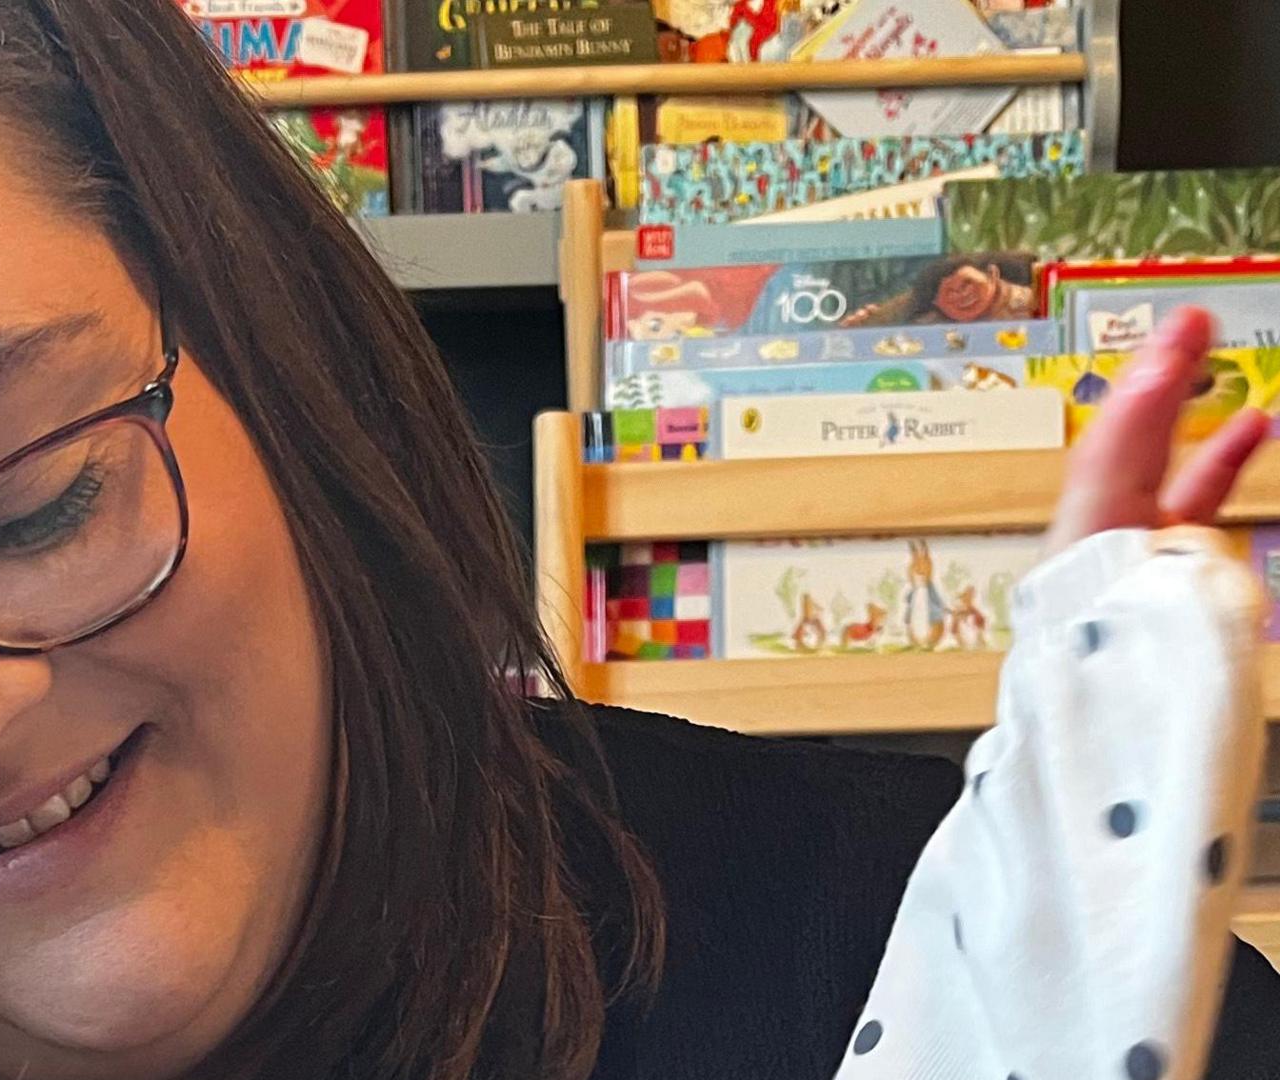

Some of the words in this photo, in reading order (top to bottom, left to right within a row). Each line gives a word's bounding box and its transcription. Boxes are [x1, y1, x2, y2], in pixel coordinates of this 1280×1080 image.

[511, 19, 541, 38] THE
[547, 17, 583, 35] TALE
[588, 18, 611, 34] OF
[494, 42, 573, 60] BENJAMIN
[576, 38, 631, 56] BUNNY
[792, 273, 831, 289] Disney
[776, 289, 847, 325] 100
[820, 420, 878, 442] PETER
[904, 417, 969, 440] RABBIT
